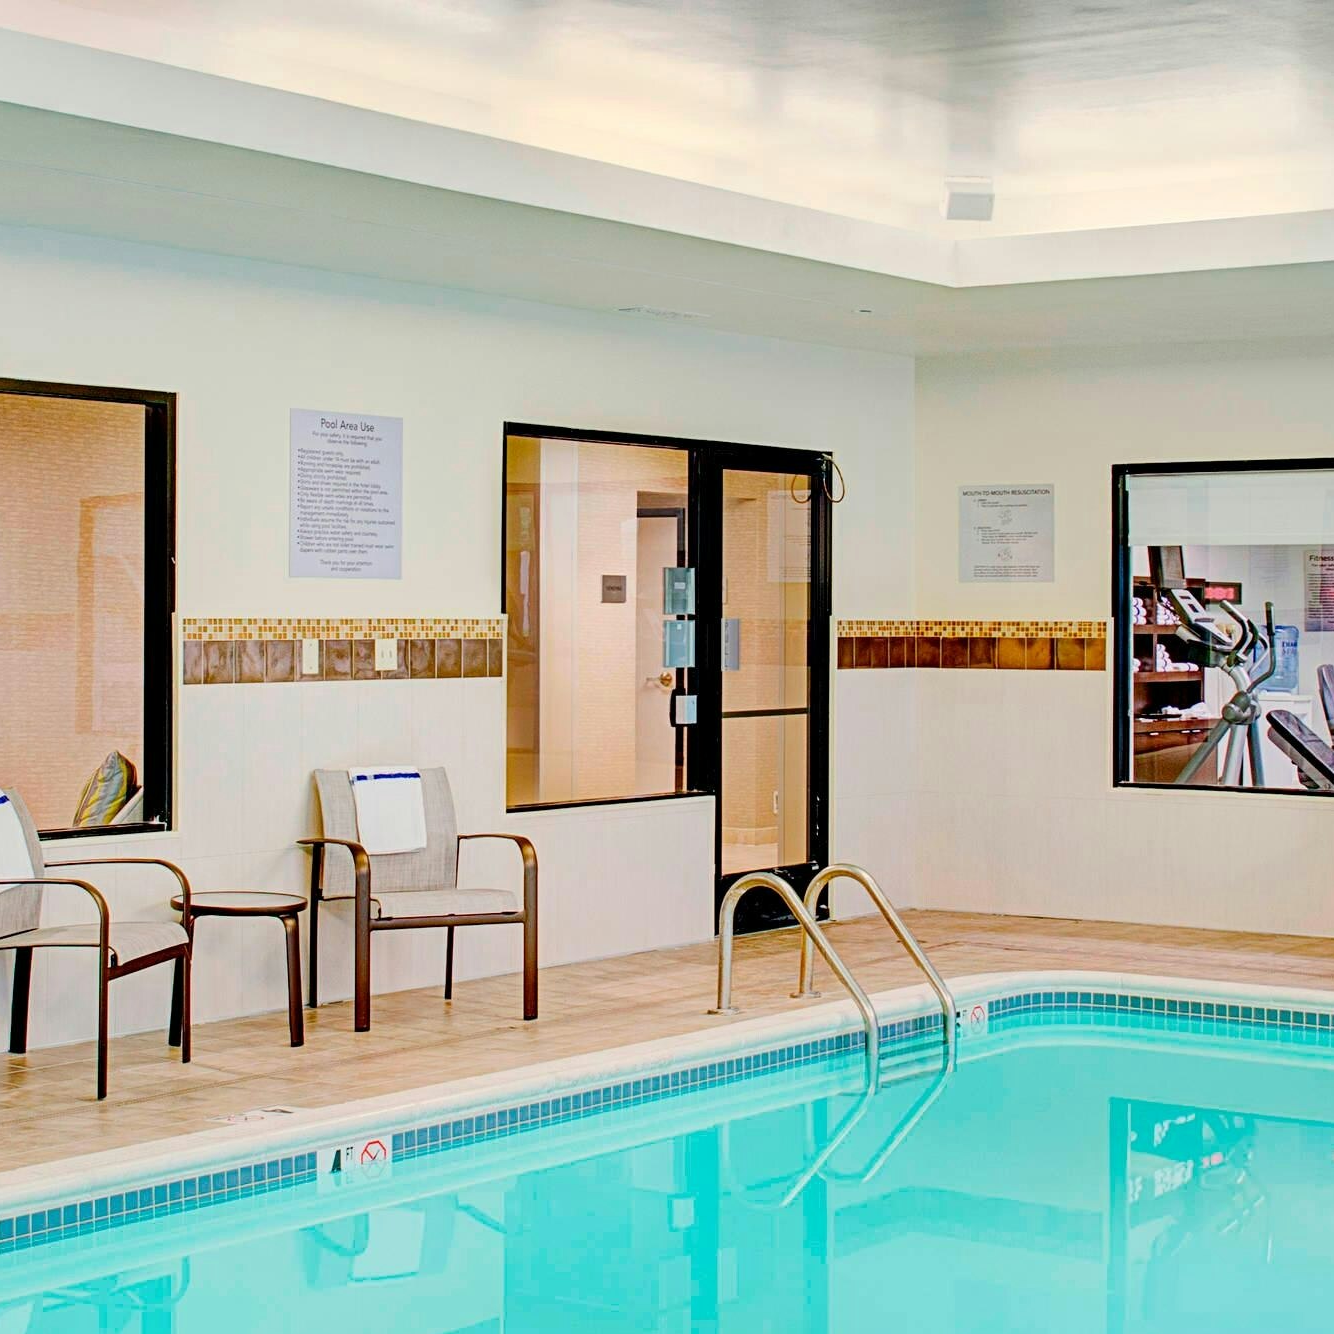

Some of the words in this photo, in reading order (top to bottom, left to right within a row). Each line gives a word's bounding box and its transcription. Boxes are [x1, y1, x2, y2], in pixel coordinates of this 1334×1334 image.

[321, 418, 338, 430] Pool
[340, 420, 358, 431] Area
[360, 422, 375, 432] Use
